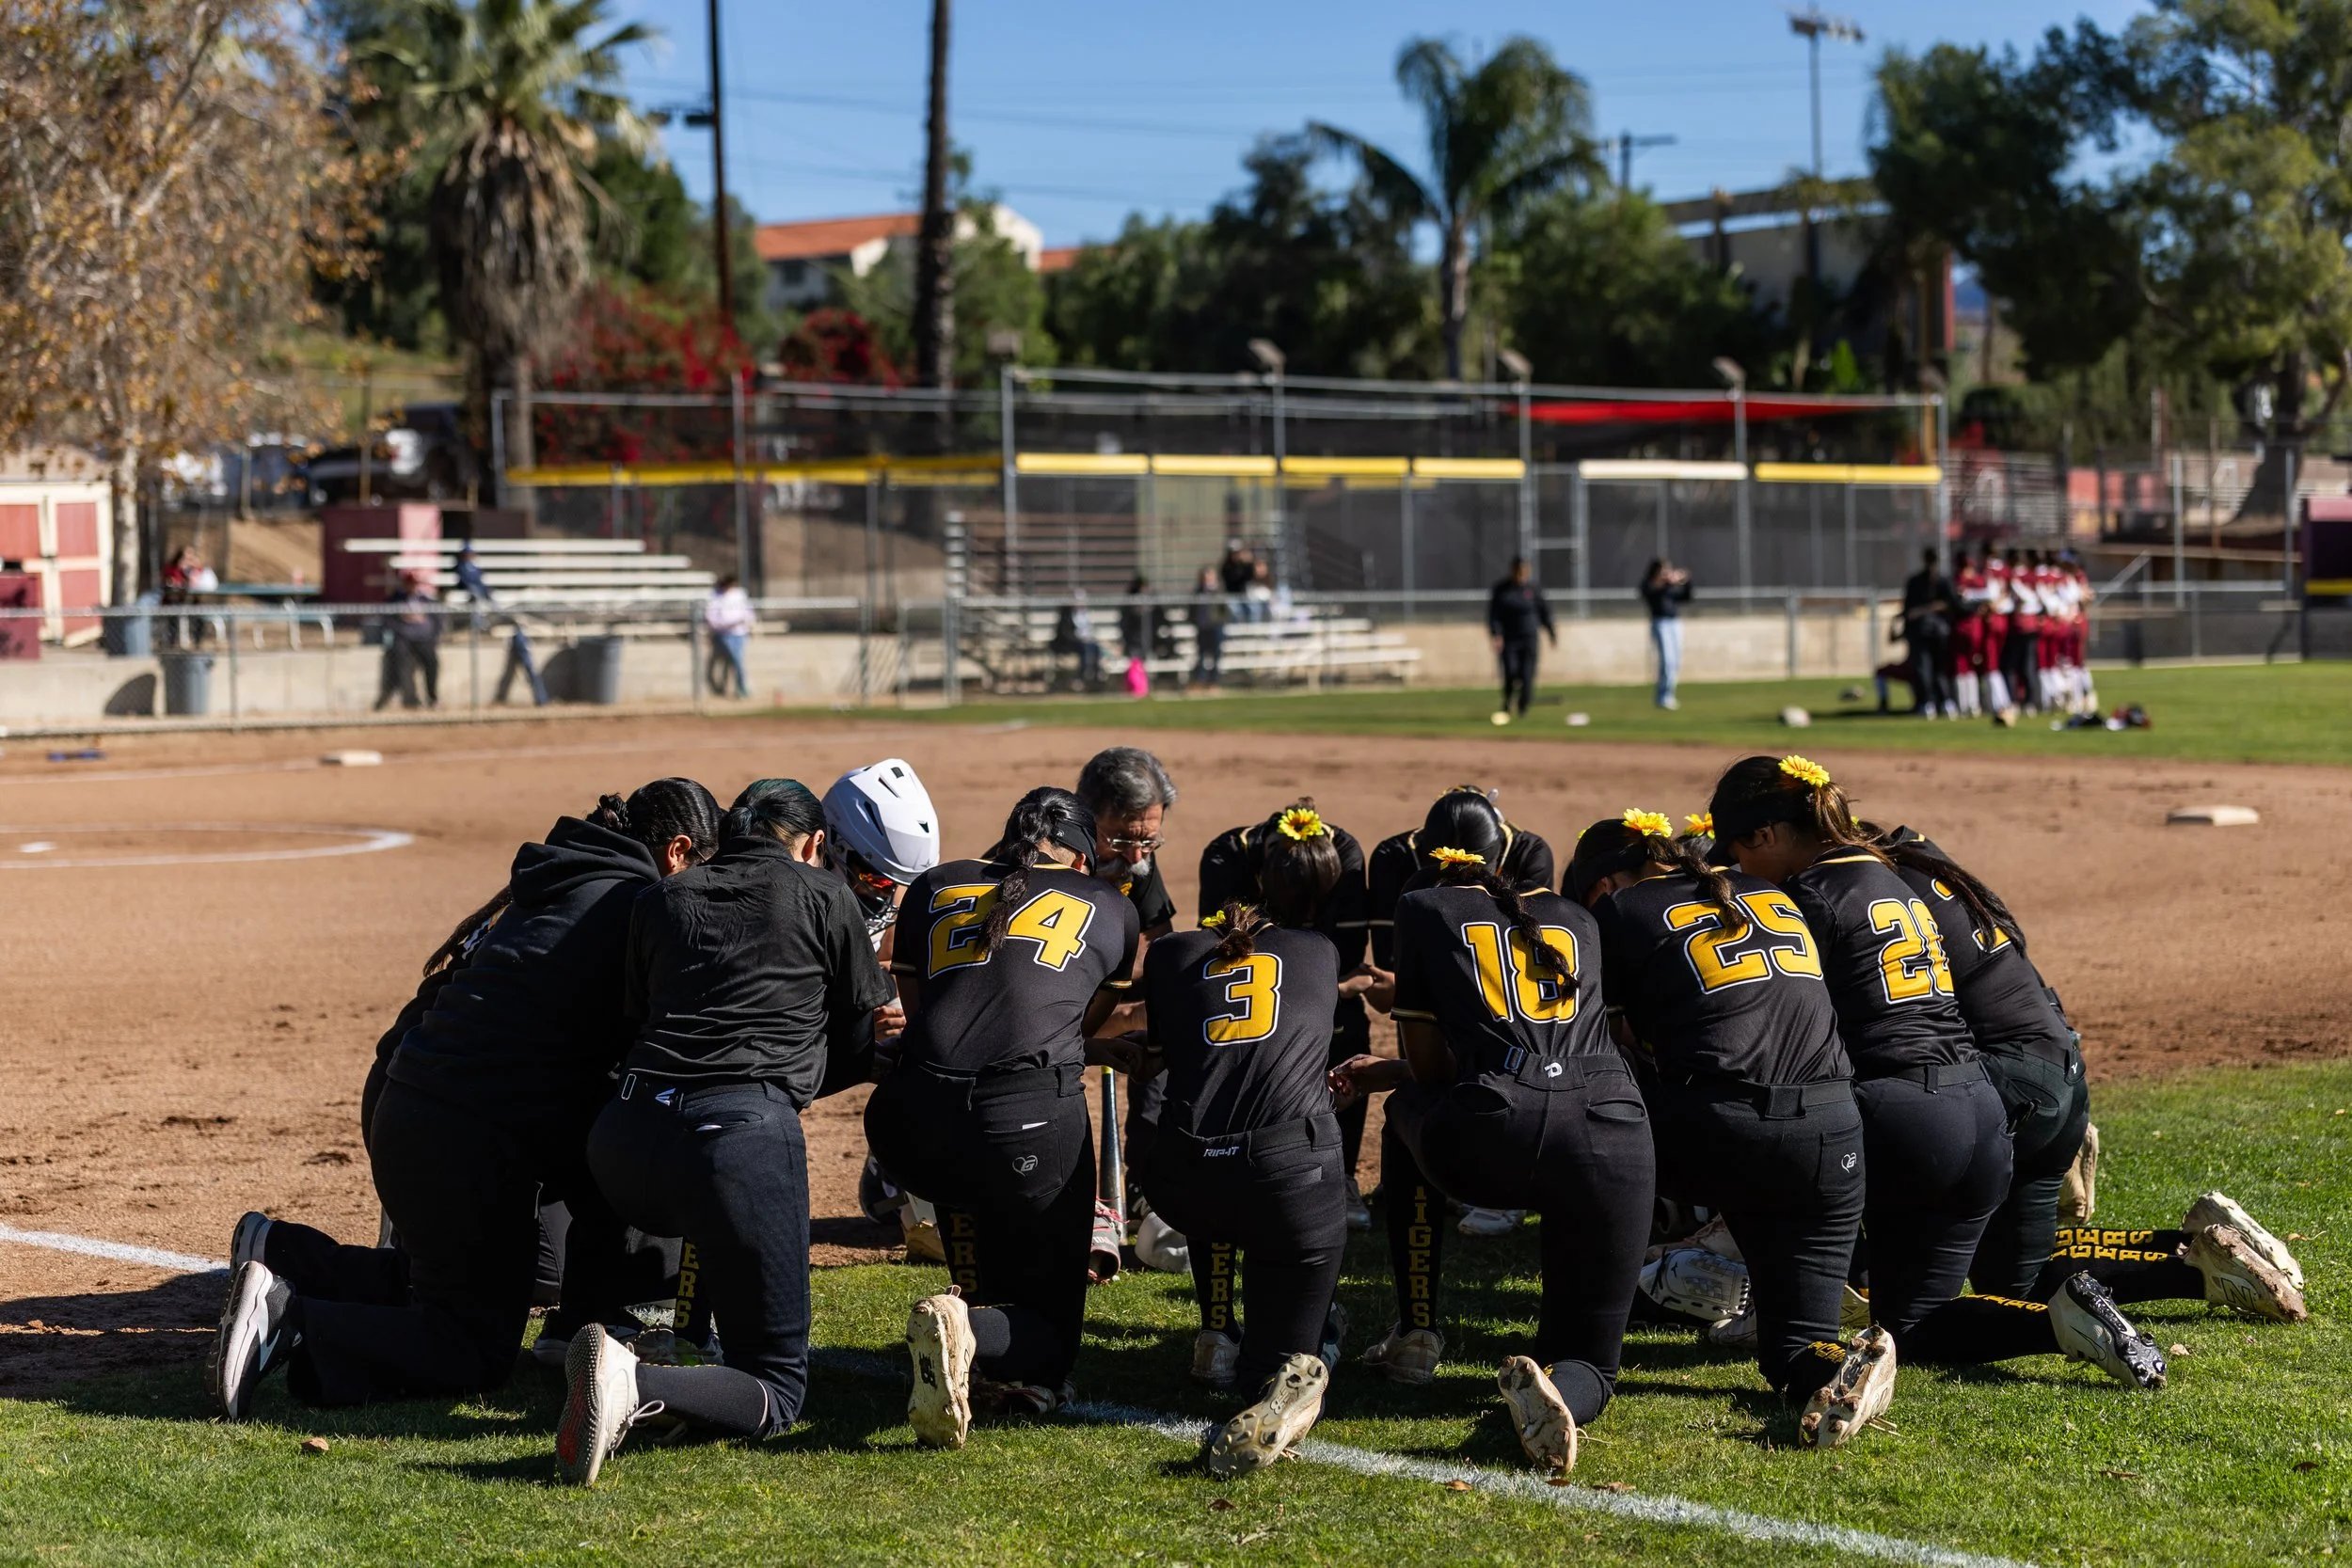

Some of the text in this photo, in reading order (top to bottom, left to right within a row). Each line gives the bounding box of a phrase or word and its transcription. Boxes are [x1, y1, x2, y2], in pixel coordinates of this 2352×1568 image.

[928, 883, 1096, 980] 24
[1461, 921, 1581, 1024] 18
[1663, 889, 1823, 995] 25
[1202, 952, 1282, 1047] 3
